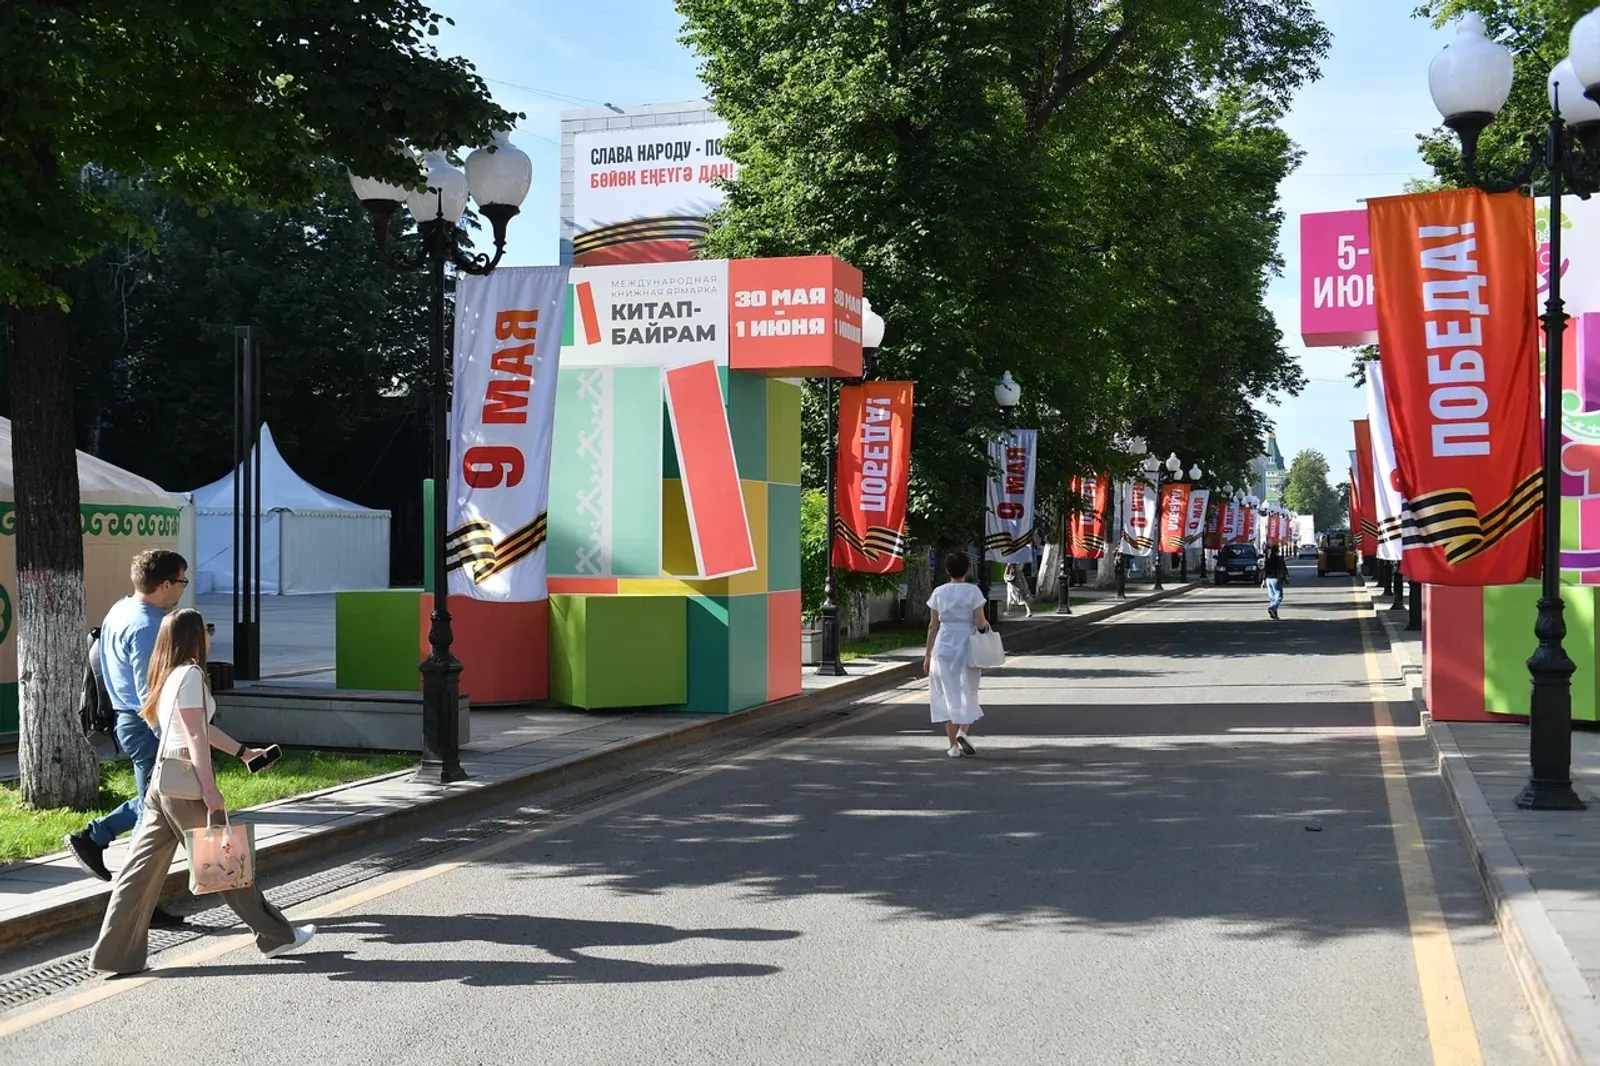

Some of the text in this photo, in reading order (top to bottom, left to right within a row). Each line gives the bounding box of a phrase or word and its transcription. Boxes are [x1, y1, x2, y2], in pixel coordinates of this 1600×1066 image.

[590, 145, 633, 165] СЛАВА
[637, 140, 692, 161] НАРОДУ
[705, 138, 724, 156] ПО
[590, 169, 636, 188] БӨЙӨК
[698, 163, 734, 183] ДАН!
[1337, 235, 1370, 270] 5-
[611, 275, 717, 288] МЕЖДУНАРОДНАЯ
[611, 285, 717, 298] КНИЖНАЯ ЯРМАРКА
[734, 287, 826, 307] 30 МАЯ
[611, 300, 702, 321] КИТАП-
[611, 321, 716, 345] БАЙРАМ
[735, 317, 825, 337] 1 ИЮНЯ
[1418, 221, 1490, 457] ПОБЕДА!
[462, 308, 540, 489] 9 МАЯ
[997, 447, 1027, 520] 9 МАЯ
[1193, 497, 1204, 519] МАЯ
